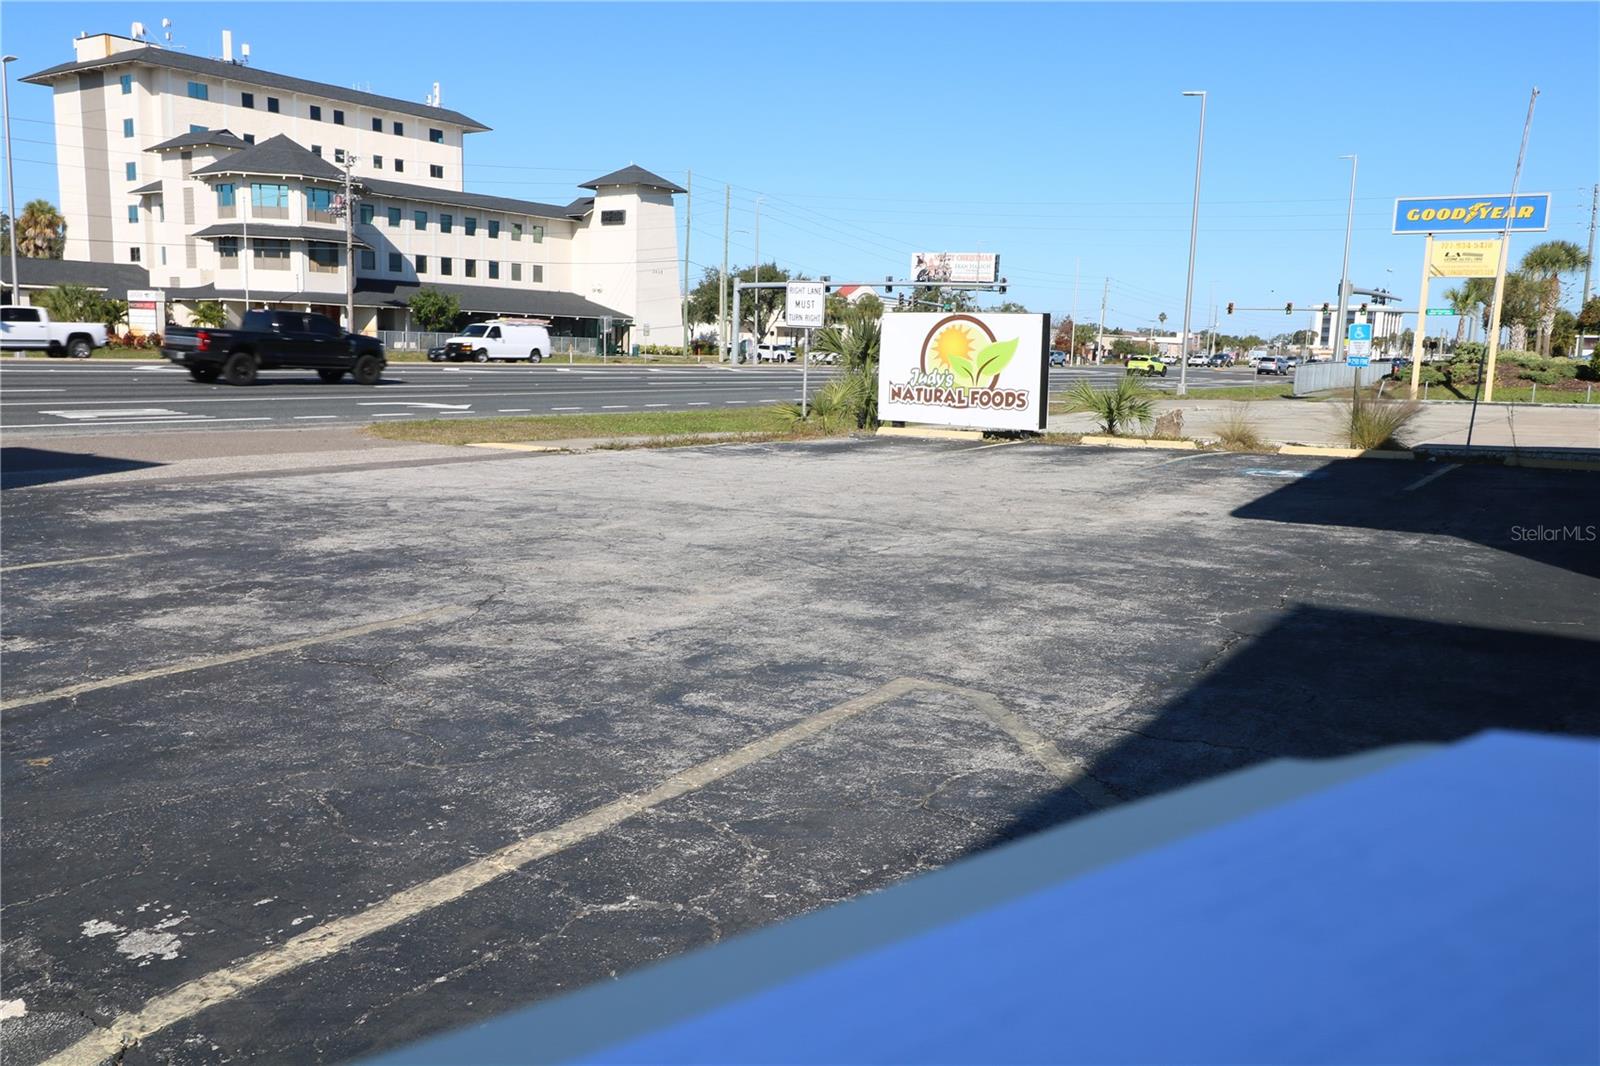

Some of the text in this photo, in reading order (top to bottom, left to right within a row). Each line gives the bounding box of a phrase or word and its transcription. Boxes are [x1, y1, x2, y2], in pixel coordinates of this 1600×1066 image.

[1407, 204, 1536, 222] GOODYEAR
[790, 286, 822, 295] RIGHT LANE
[795, 299, 815, 309] MUST
[789, 313, 821, 322] TURN RIGHT
[910, 367, 954, 387] Judy's
[889, 384, 1029, 411] NATURAL FOODS
